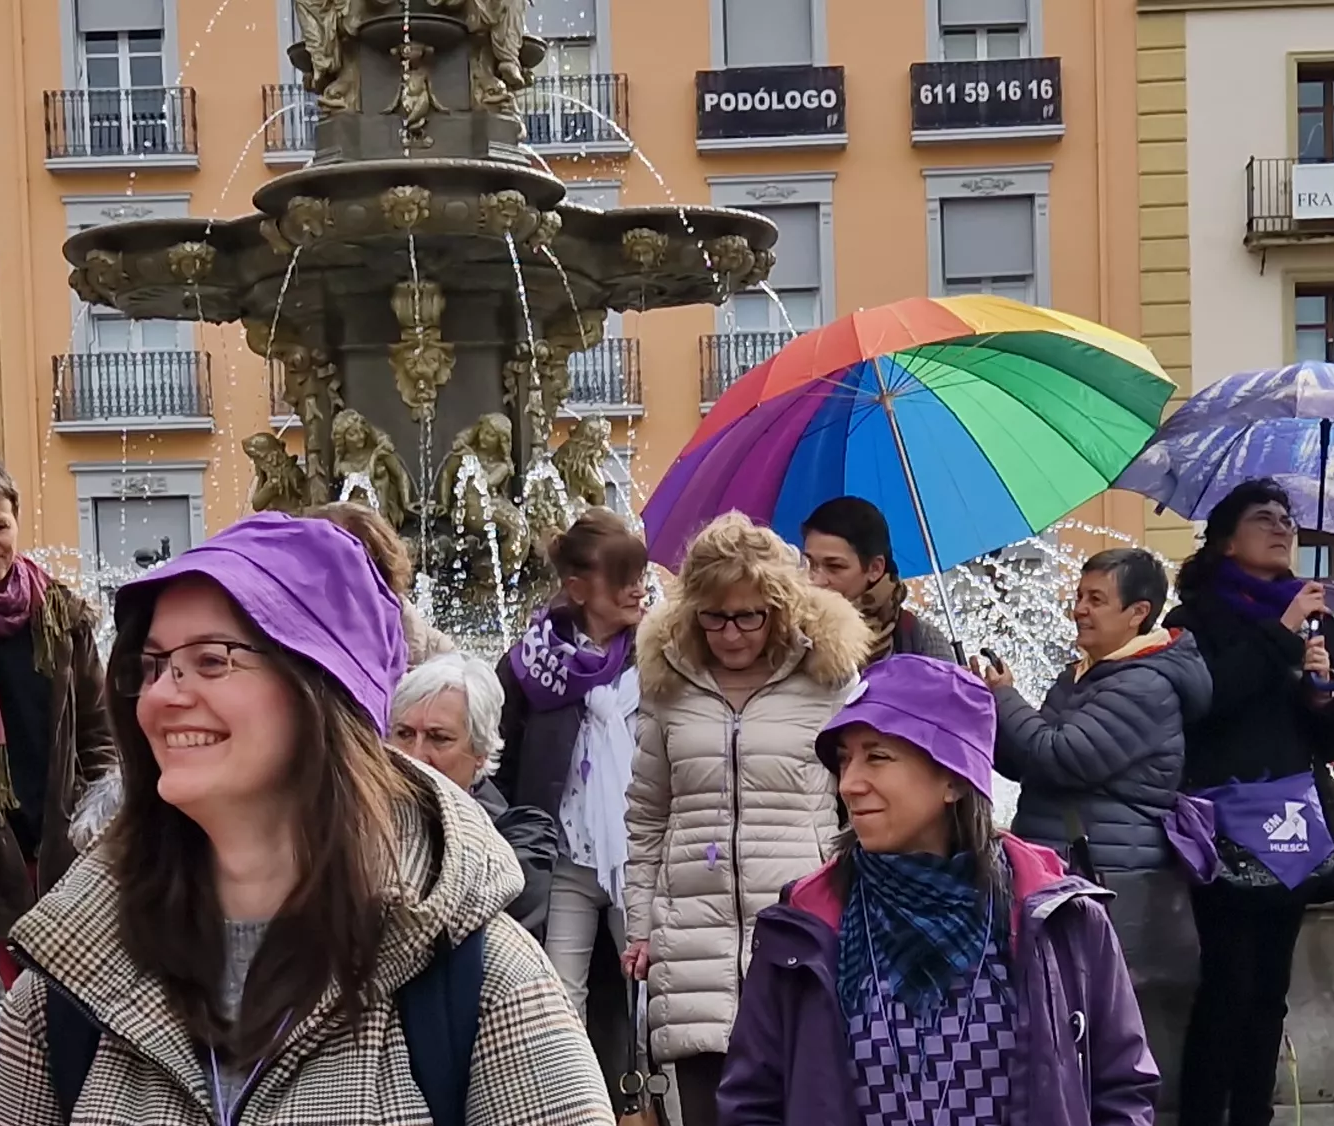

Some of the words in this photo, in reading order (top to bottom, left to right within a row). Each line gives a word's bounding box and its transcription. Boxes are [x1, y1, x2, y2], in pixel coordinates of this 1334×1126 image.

[704, 88, 837, 112] PODÓLOGO
[920, 85, 958, 105] 611
[964, 83, 990, 103] 59
[996, 81, 1021, 101] 16
[1028, 79, 1054, 100] 16
[1270, 843, 1310, 852] HUESCA
